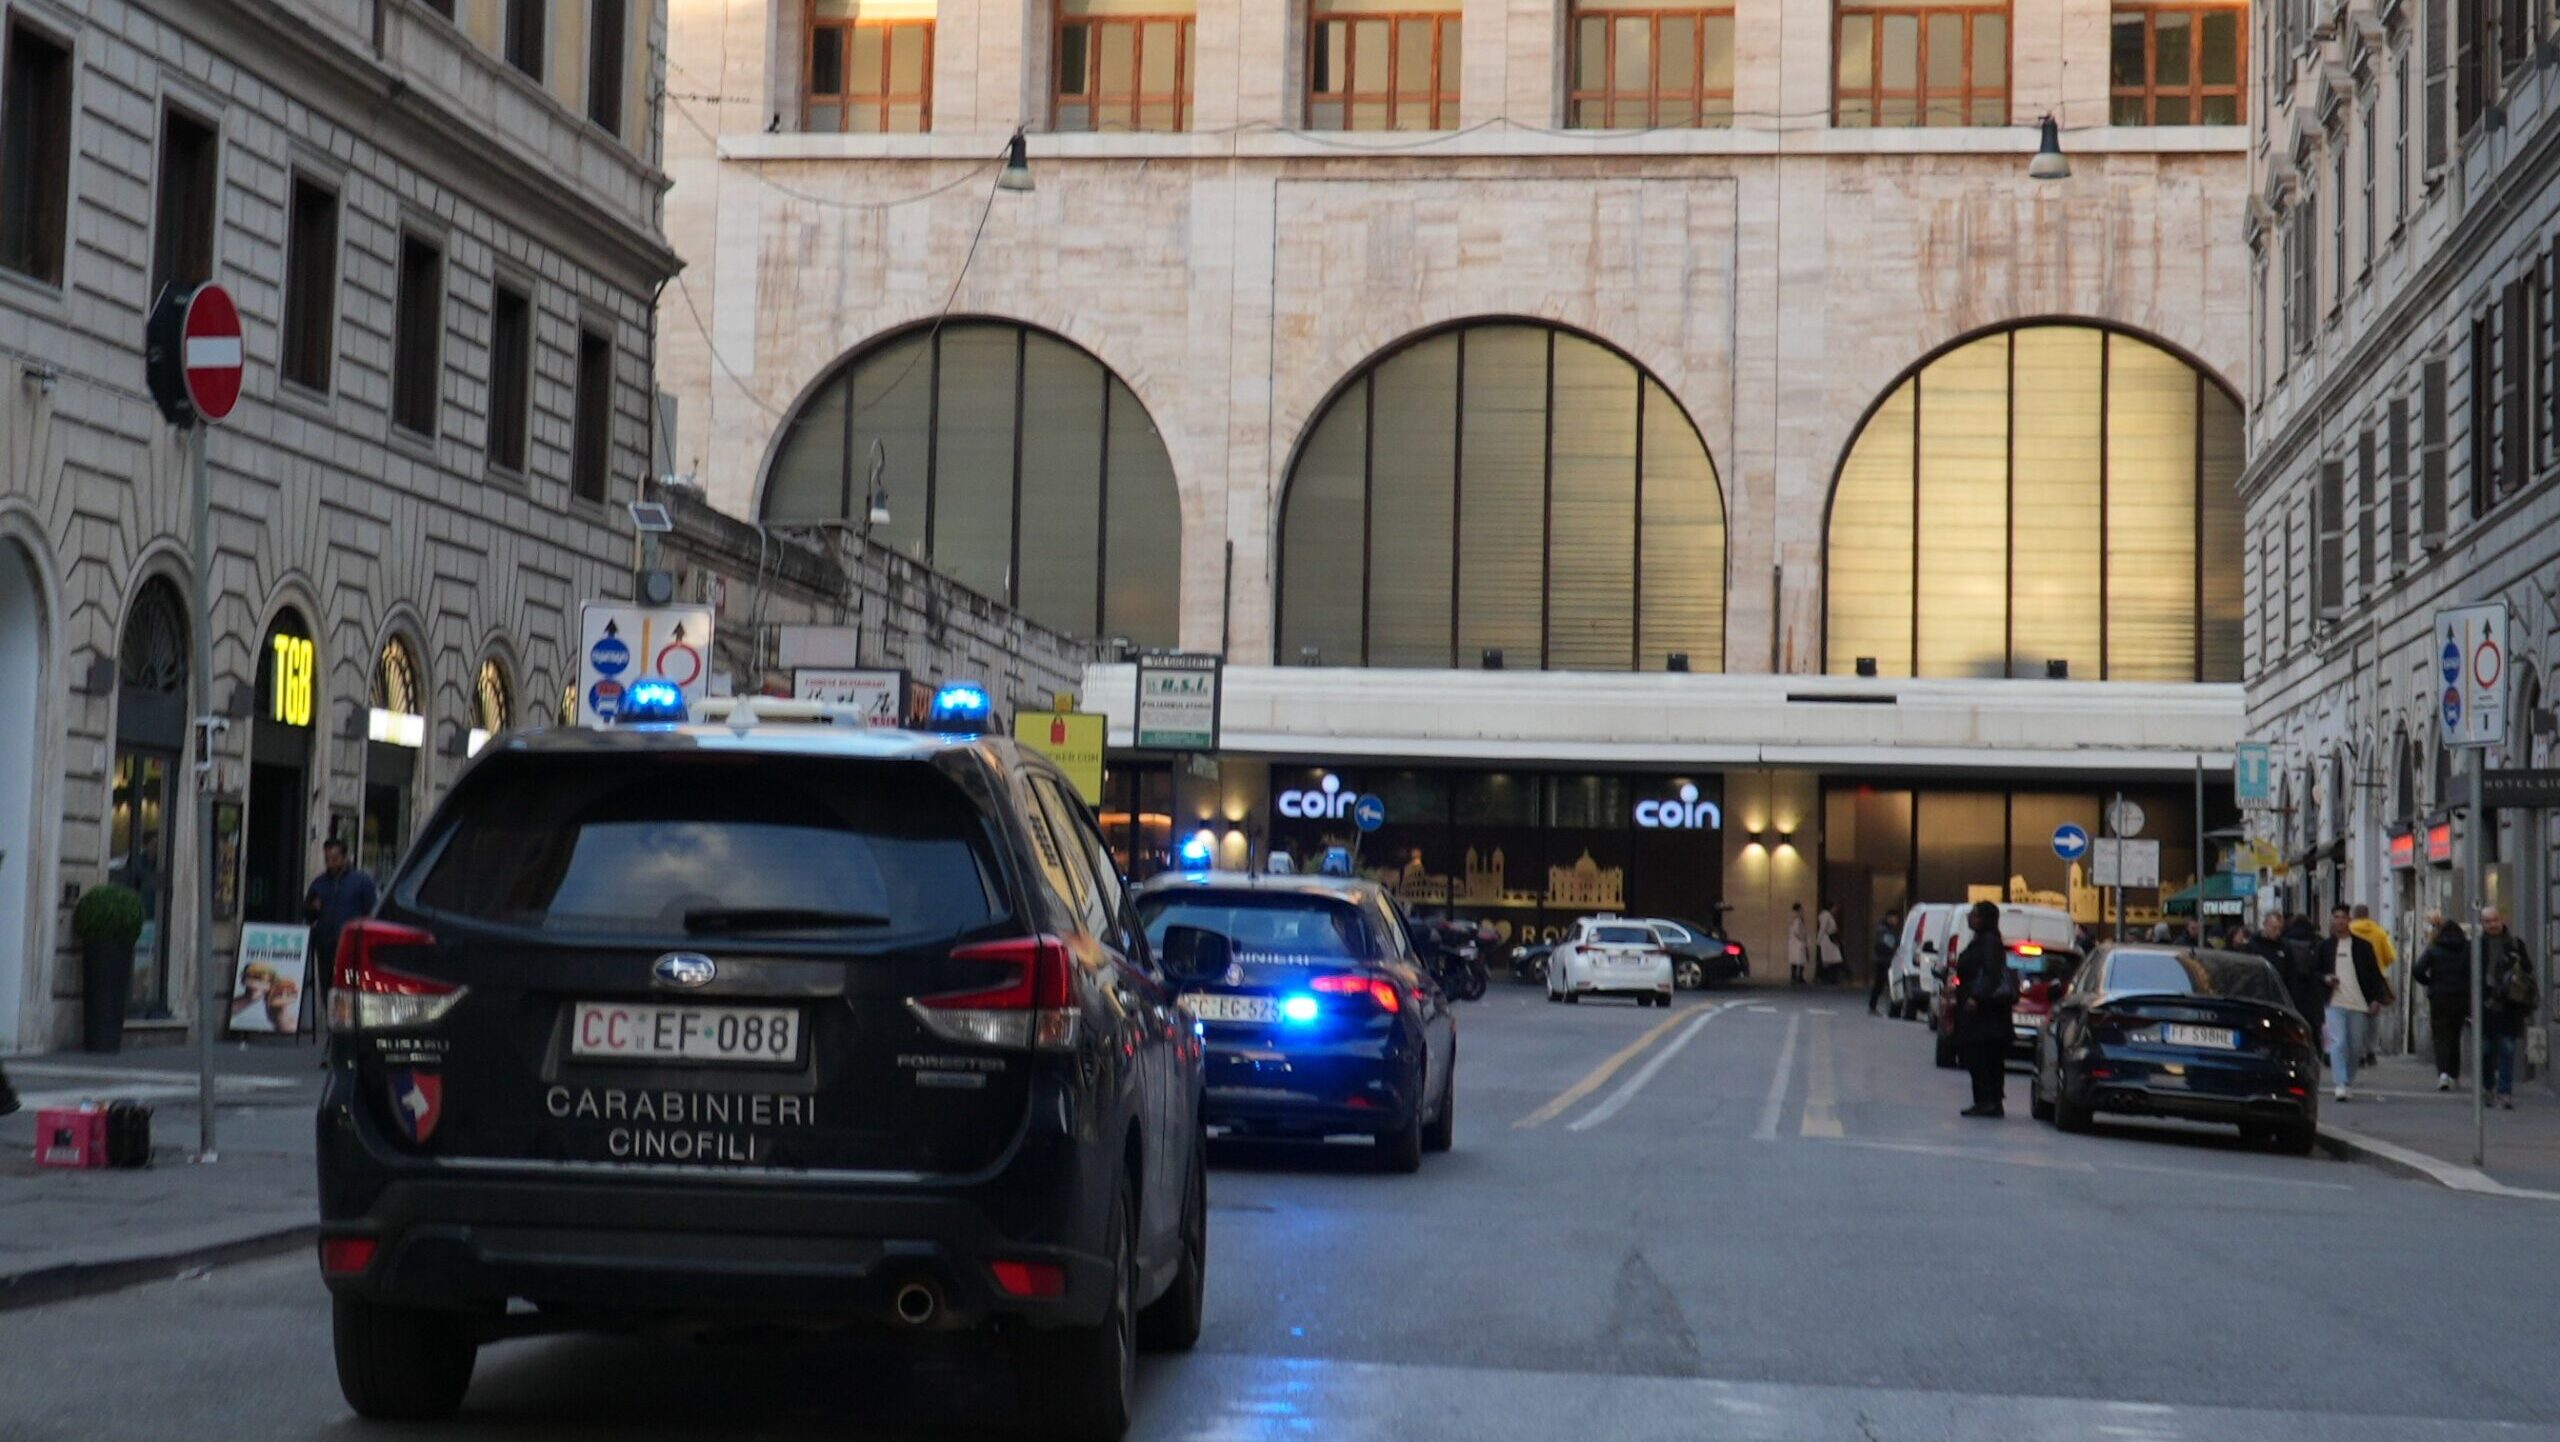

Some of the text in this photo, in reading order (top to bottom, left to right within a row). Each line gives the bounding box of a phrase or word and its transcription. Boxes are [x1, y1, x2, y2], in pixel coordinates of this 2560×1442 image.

[1636, 783, 1720, 829] coin
[582, 1010, 789, 1054] CC EF 088
[547, 1085, 814, 1126] CARABINIERI
[608, 1127, 755, 1161] CINOFILI
